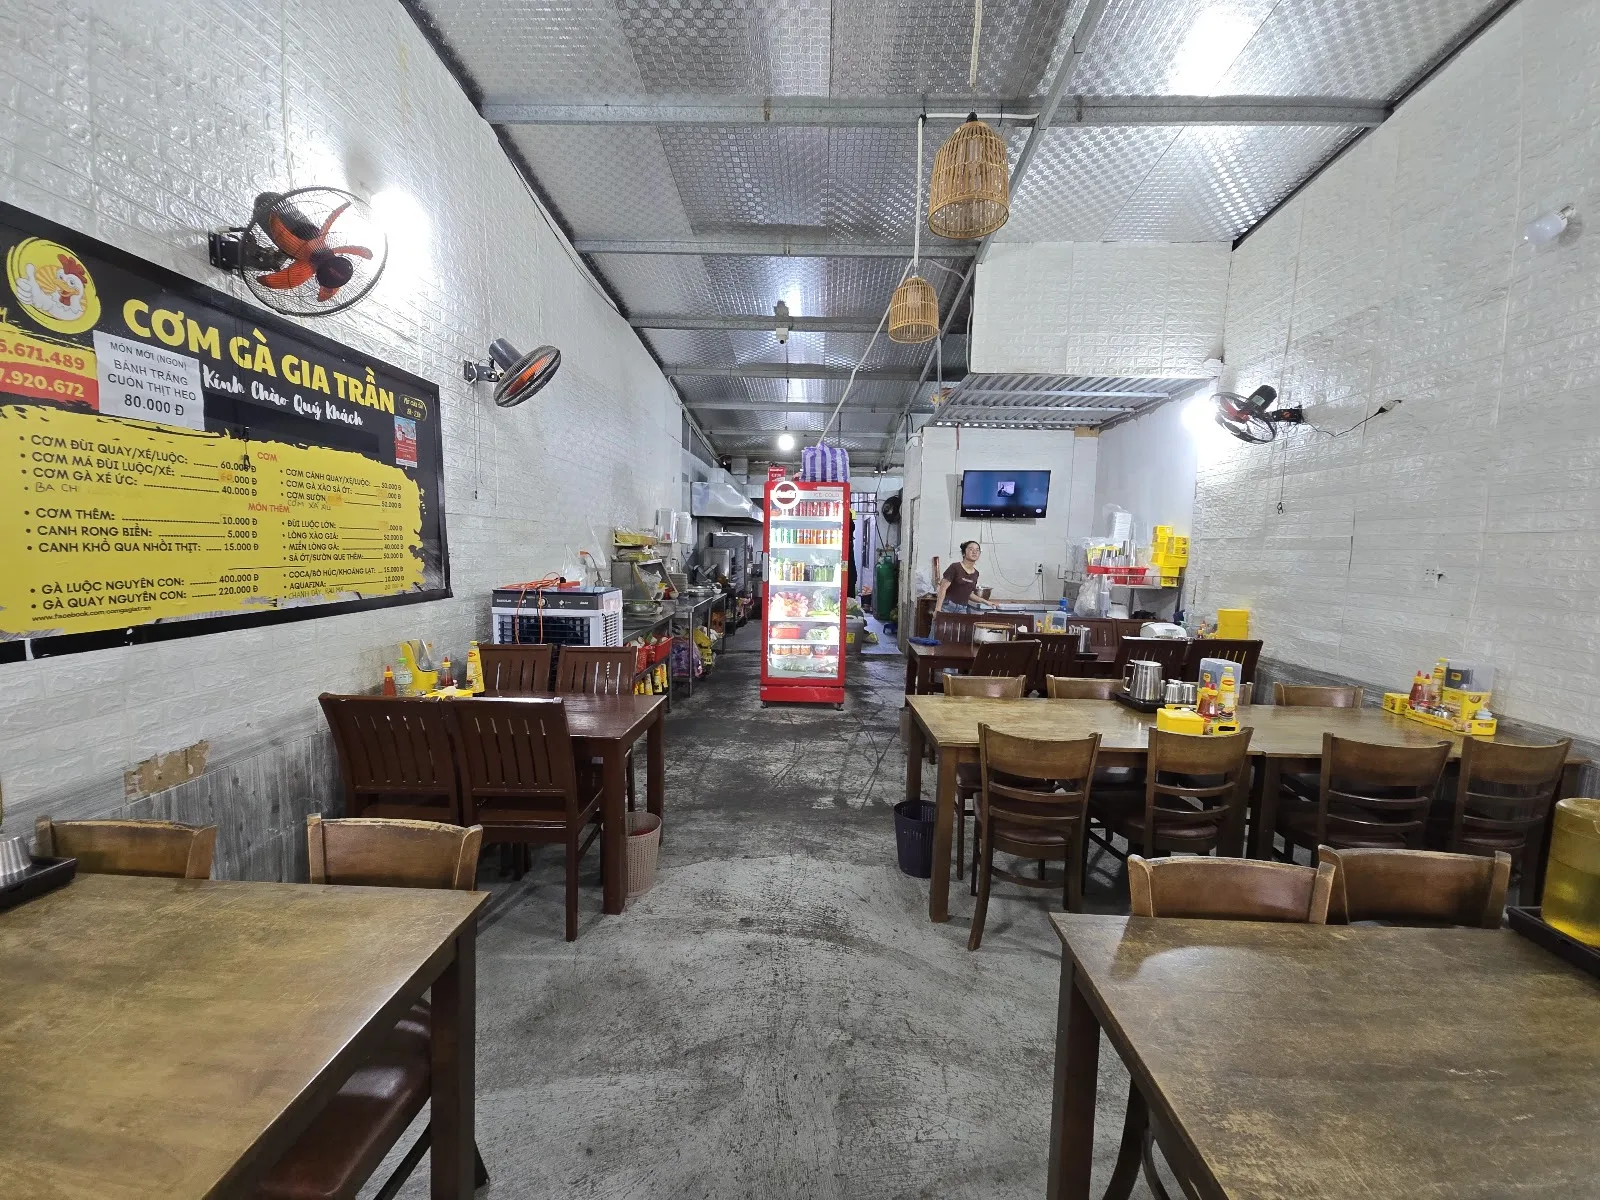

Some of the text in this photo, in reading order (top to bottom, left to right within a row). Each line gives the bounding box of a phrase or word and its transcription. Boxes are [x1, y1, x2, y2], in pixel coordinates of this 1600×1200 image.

[110, 341, 133, 355] MÓN
[156, 354, 187, 370] (NGON)
[123, 299, 395, 415] CƠM GÀ GIA TRẦN
[114, 359, 189, 386] BÁNH TRÁNG
[146, 381, 171, 397] THỊT
[174, 387, 196, 401] HEO
[202, 364, 364, 427] Kính Chào Quý Khách
[124, 394, 184, 416] 80.000 Đ
[31, 434, 67, 449] CƠM
[70, 438, 95, 451] ĐÙI
[32, 451, 68, 465] CƠM
[72, 455, 94, 467] MÁ
[96, 457, 119, 470] ĐÙI
[257, 451, 278, 462] CƠM
[286, 468, 304, 478] CƠM
[305, 471, 325, 480] CÁNH
[33, 467, 69, 480] CƠM
[73, 470, 93, 482] GÀ
[96, 472, 112, 484] XÉ
[115, 472, 138, 486] ỨC:
[222, 486, 250, 496] 40.000
[35, 481, 55, 493] BA
[286, 479, 305, 489] CƠM
[305, 481, 315, 491] GÀ
[317, 481, 332, 492] XÀO
[286, 491, 305, 500] CƠM
[306, 493, 326, 501] SƯỜN
[248, 502, 290, 513] MÓN THÊM
[36, 507, 72, 519] CƠM
[75, 507, 115, 521] THÊM:
[222, 516, 250, 525] 10.000
[287, 518, 300, 527] ĐÙI
[301, 520, 320, 529] LUỘC
[37, 525, 78, 536] CANH
[81, 526, 119, 537] RONG
[227, 530, 250, 538] 5.000
[287, 530, 307, 539] LÒNG
[309, 531, 323, 539] XÀO
[38, 542, 79, 553] CANH
[82, 537, 111, 553] KHỔ
[114, 542, 140, 552] QUA
[143, 538, 173, 552] NHỒI
[175, 542, 201, 553] THỊT:
[224, 543, 252, 551] 15.000
[288, 541, 307, 551] MIẾN
[308, 541, 327, 551] LÒNG
[333, 553, 346, 561] QUE
[288, 568, 322, 579] COCA/BÒ
[41, 582, 63, 594] GÀ
[66, 580, 102, 594] LUỘC
[105, 577, 154, 591] NGUYÊN
[157, 577, 185, 587] CON:
[219, 574, 252, 583] 400.000
[289, 581, 326, 590] AQUAFINA:
[42, 596, 64, 610] GÀ
[67, 595, 105, 608] QUAY
[108, 591, 157, 605] NGUYÊN
[159, 590, 187, 600] CON:
[218, 585, 251, 596] 220.000
